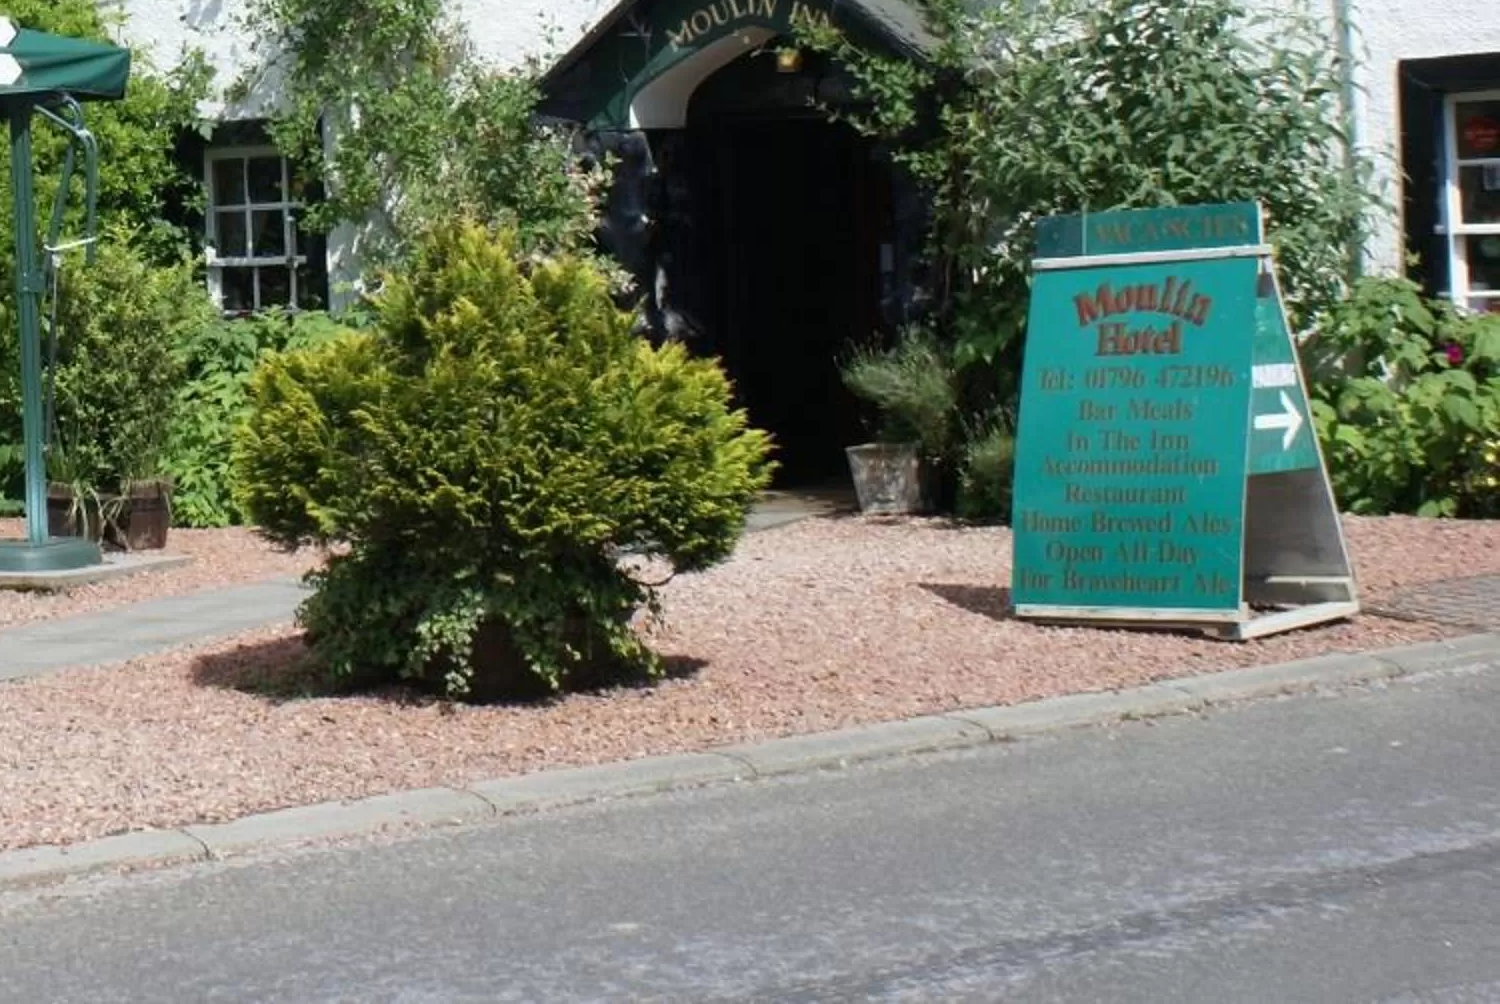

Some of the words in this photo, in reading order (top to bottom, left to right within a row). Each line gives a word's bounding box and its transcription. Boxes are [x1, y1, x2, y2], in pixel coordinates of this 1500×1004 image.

[1073, 276, 1213, 328] Moulin
[1094, 322, 1183, 356] Hotel
[1083, 364, 1145, 388] 01796
[1077, 400, 1116, 422] Bar
[1126, 399, 1194, 421] Meals
[1066, 431, 1090, 452] In
[1101, 429, 1141, 452] The
[1150, 429, 1190, 451] Inn
[1041, 453, 1218, 477] Accommodation
[1065, 482, 1187, 504] Restaurant
[1020, 511, 1082, 534] Home
[1091, 510, 1173, 534] Brewed
[1184, 510, 1232, 534] Ales
[1045, 541, 1104, 568] Open
[1113, 541, 1152, 564] All
[1157, 540, 1200, 567] Day
[1019, 569, 1053, 591] For
